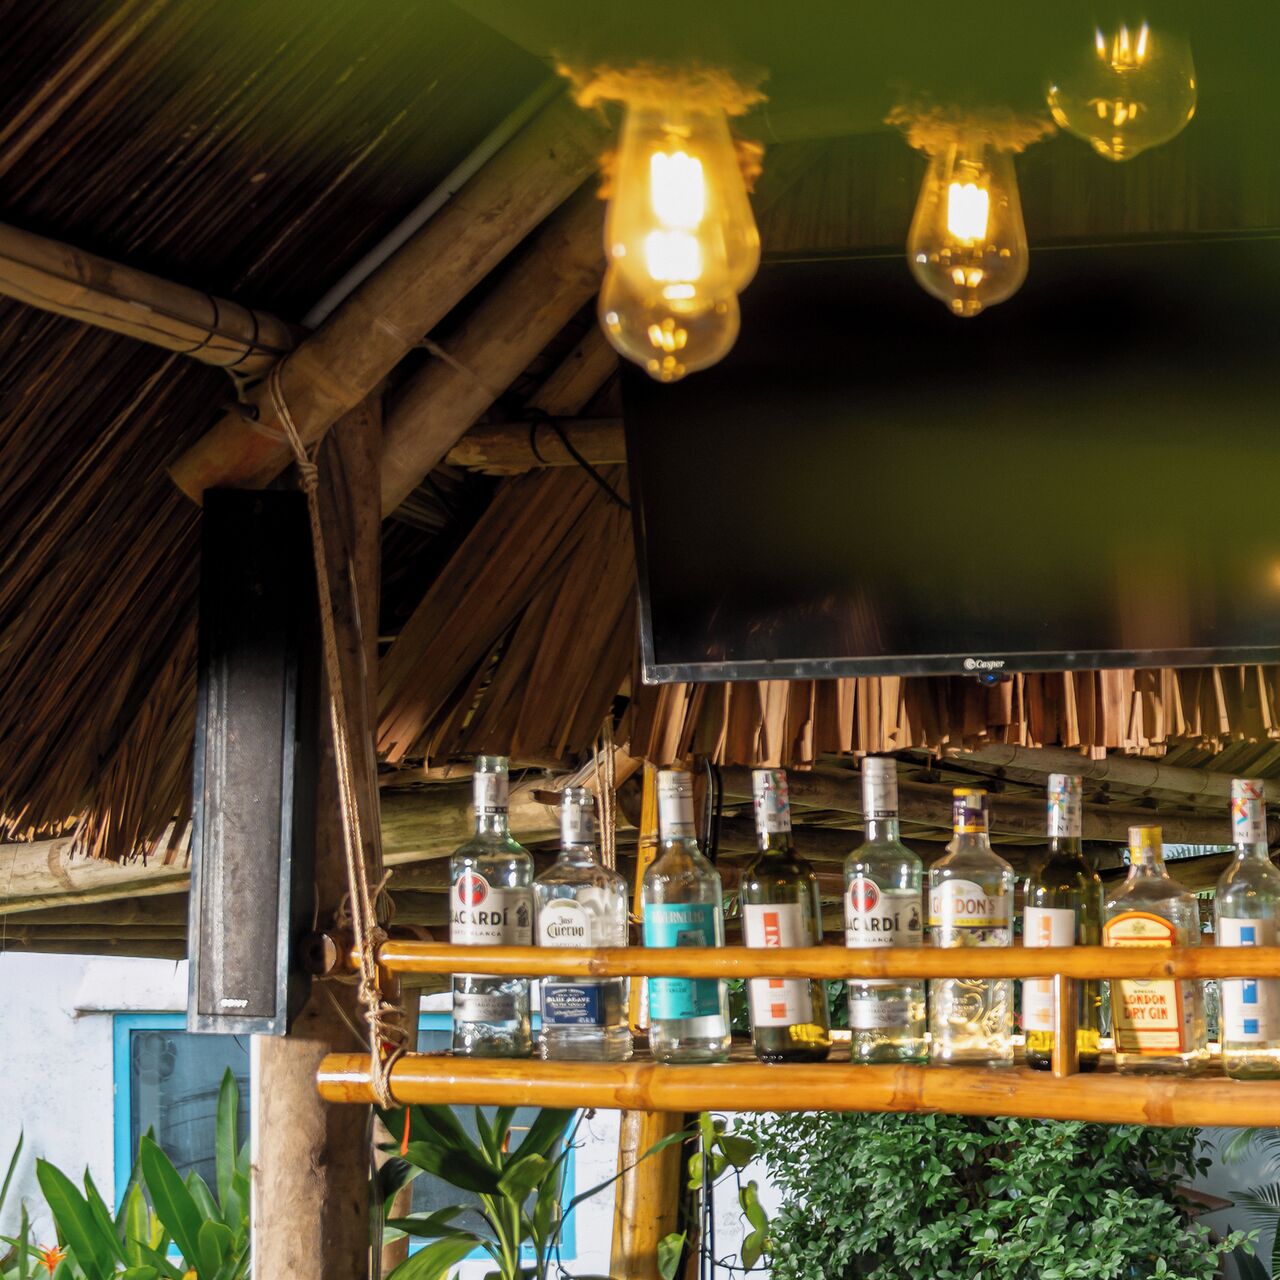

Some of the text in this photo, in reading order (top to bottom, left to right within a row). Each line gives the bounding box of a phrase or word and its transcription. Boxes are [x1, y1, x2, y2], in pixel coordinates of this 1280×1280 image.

[933, 897, 995, 914] GDON'S
[450, 907, 508, 926] ACARDÍ
[845, 912, 900, 931] ACARDÍ
[546, 922, 584, 939] Cuervo
[1123, 995, 1166, 1005] LONDON
[1124, 1007, 1168, 1020] DRY GIN
